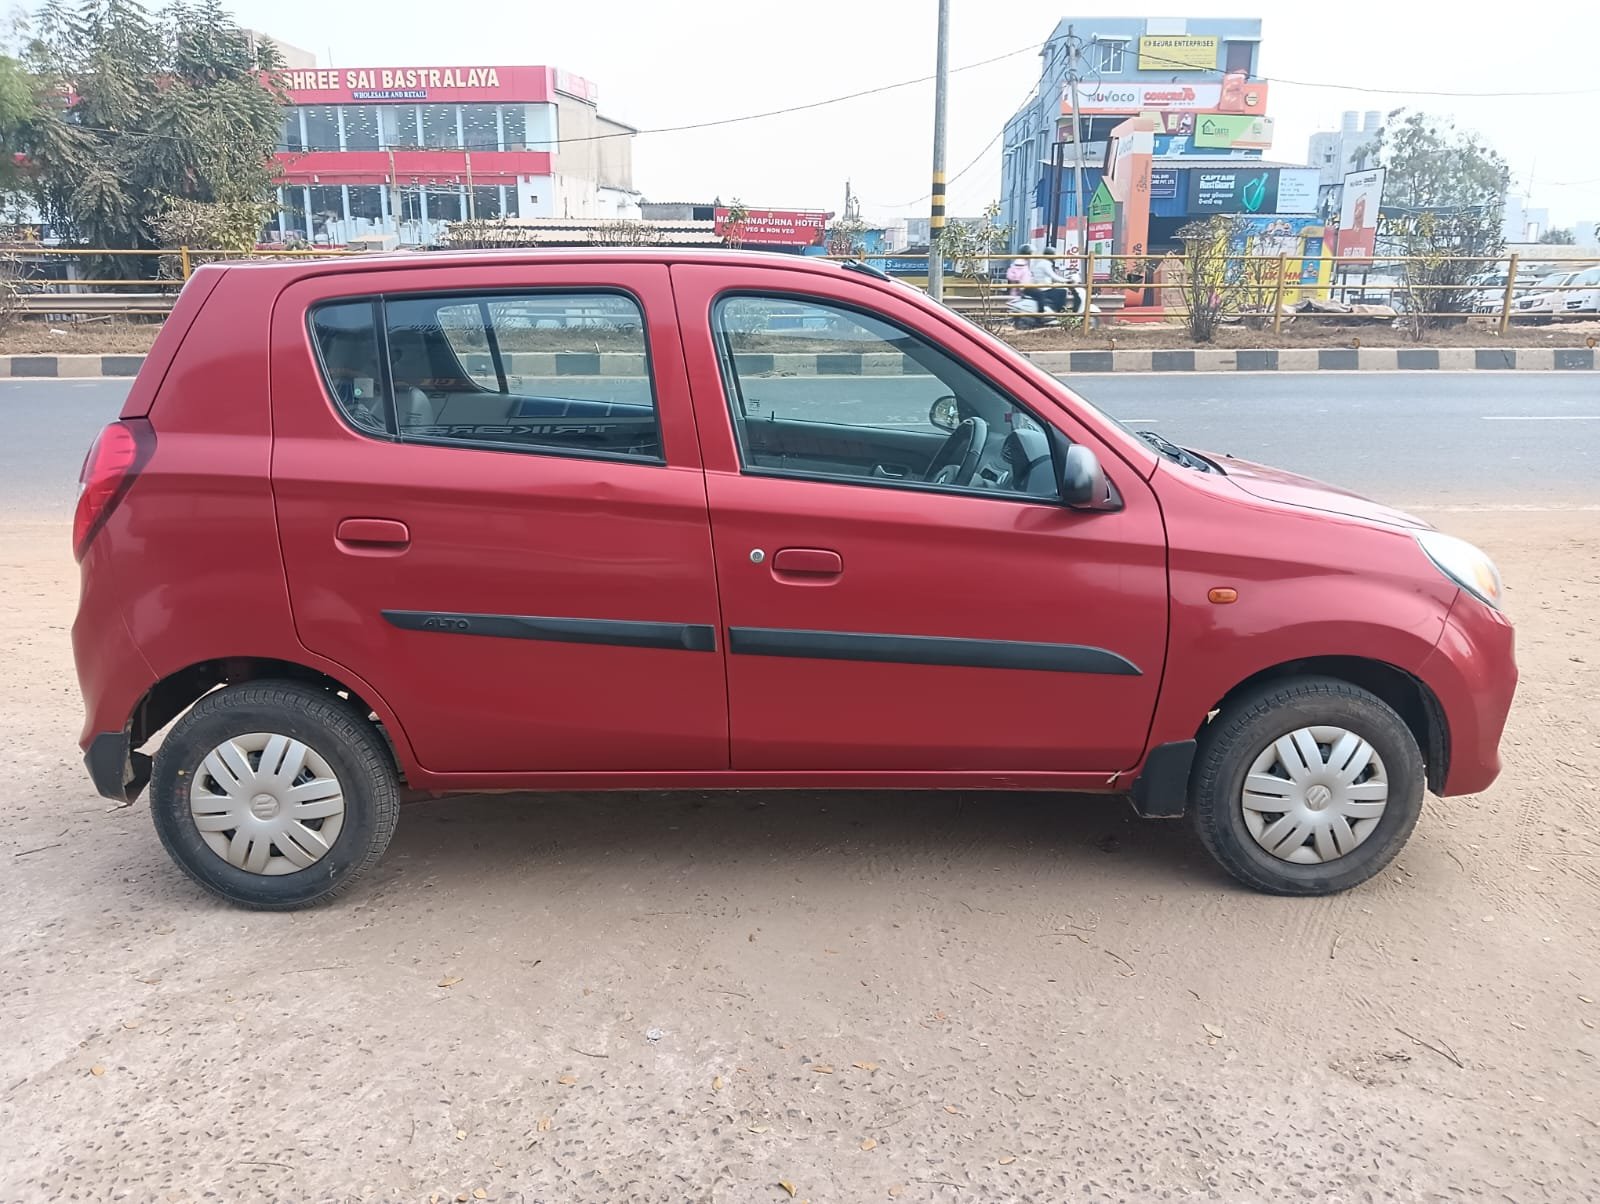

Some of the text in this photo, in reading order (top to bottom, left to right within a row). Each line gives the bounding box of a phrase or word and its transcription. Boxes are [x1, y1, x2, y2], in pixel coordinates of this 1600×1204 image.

[282, 68, 500, 90] SHREE SAI BASTRALAYA
[353, 90, 390, 99] WHOLESALE
[404, 90, 426, 98] RETAIL
[795, 219, 824, 228] HOTEL
[424, 616, 471, 630] ALTO
